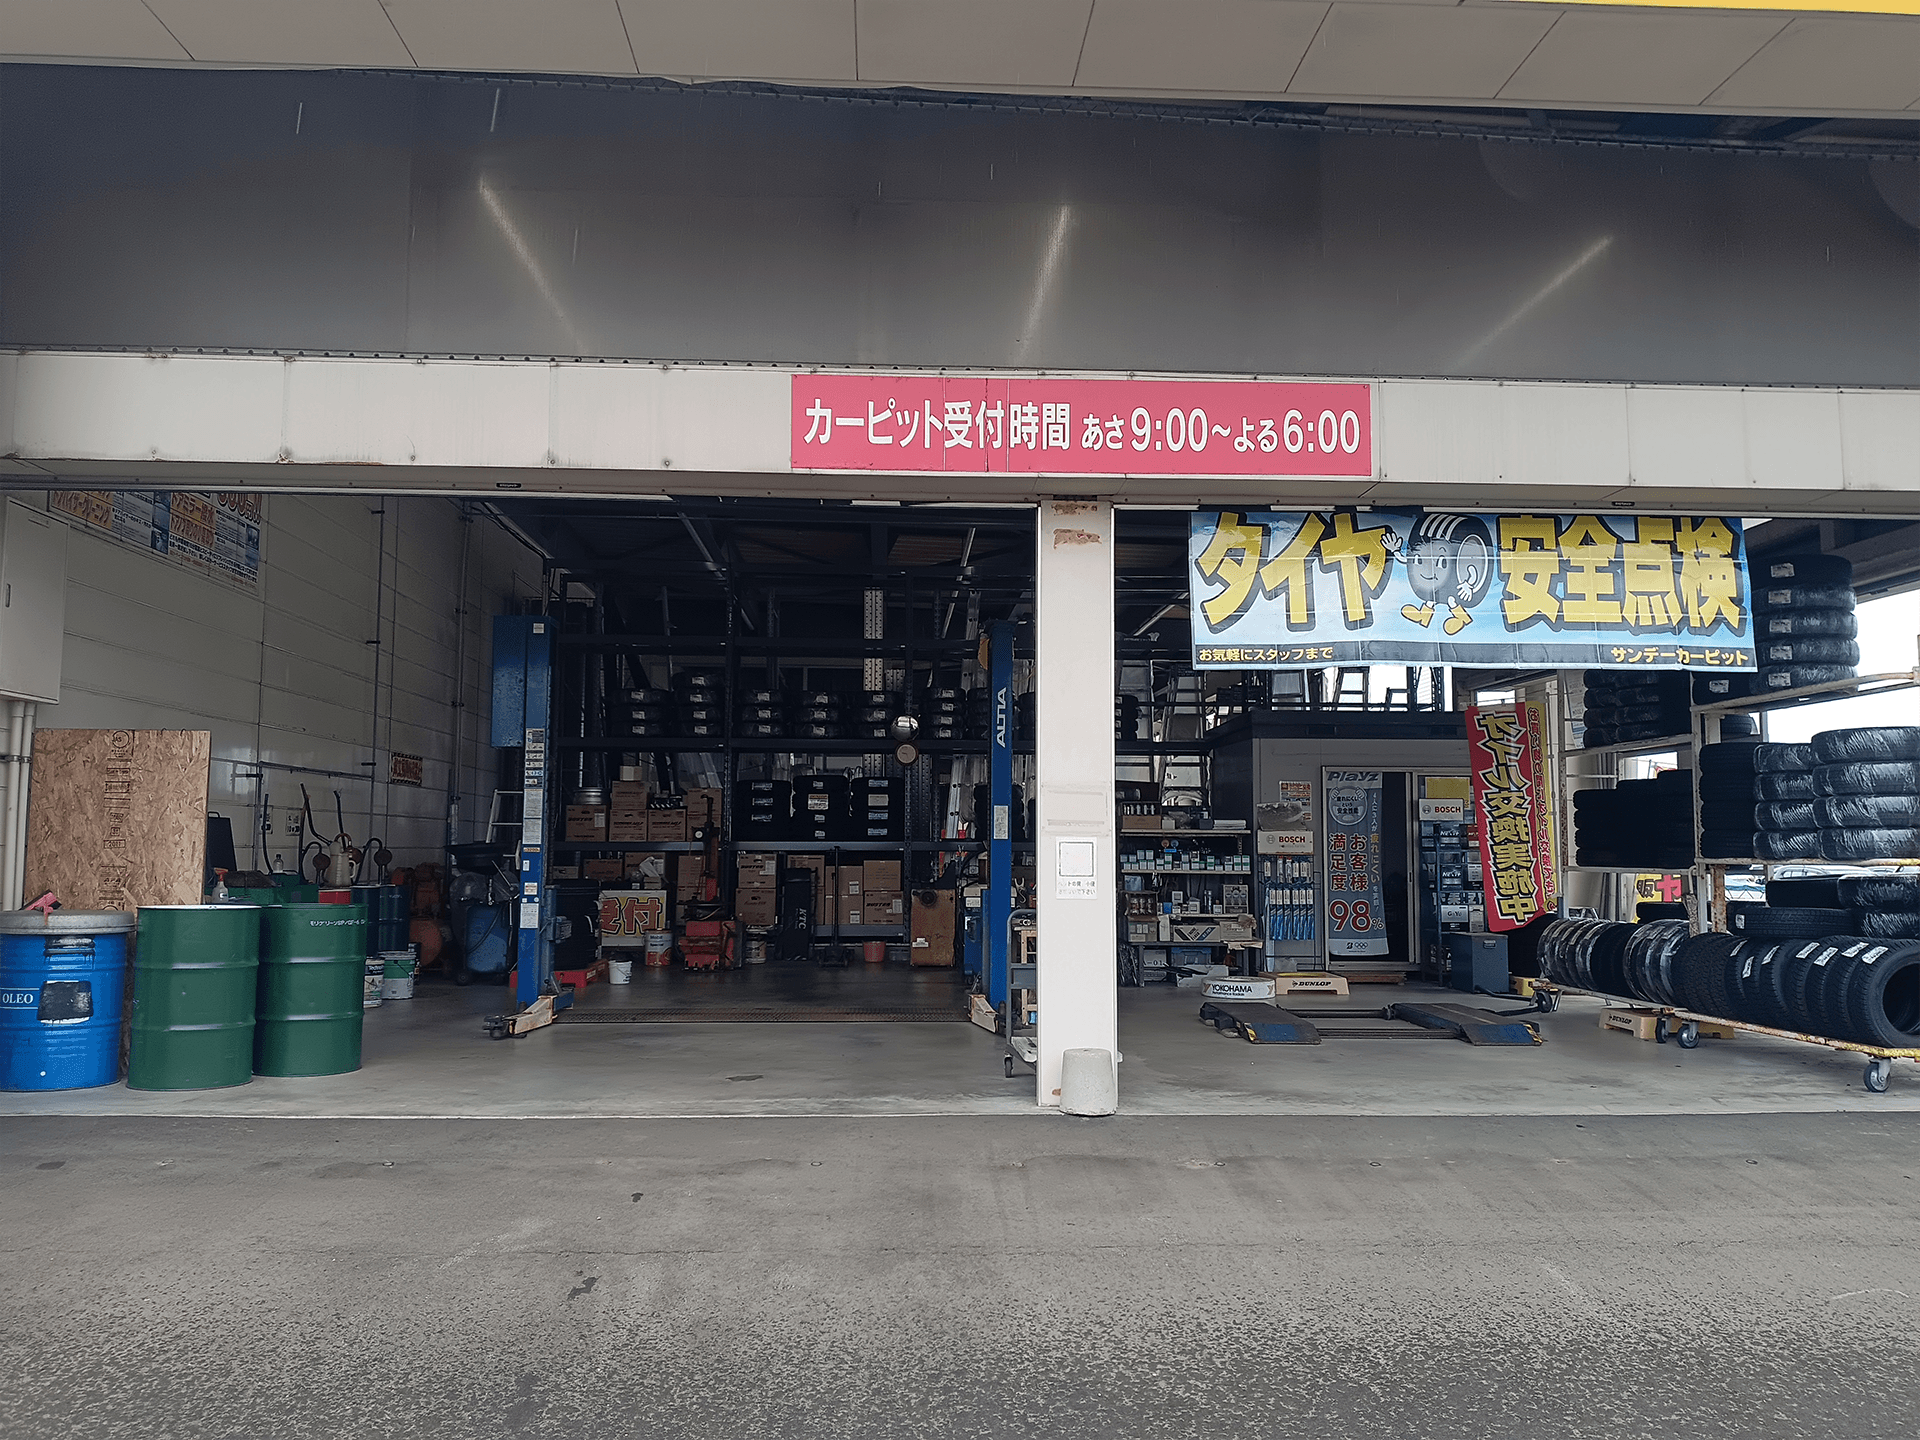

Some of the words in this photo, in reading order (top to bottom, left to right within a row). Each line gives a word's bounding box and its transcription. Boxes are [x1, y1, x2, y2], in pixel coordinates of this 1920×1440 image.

[804, 398, 1071, 450] カーピット受付時間
[1198, 511, 1391, 633] タイヤ
[1499, 513, 1745, 634] 安全点検
[1198, 647, 1334, 662] お気軽にスタッフまで
[1610, 646, 1750, 667] サンデーカーピット
[1327, 771, 1380, 782] Playz
[1328, 832, 1348, 892] 満足度
[1349, 832, 1369, 891] お客様
[799, 907, 808, 931] KTC
[1211, 983, 1253, 993] YOKOHAMA
[2, 993, 34, 1005] OLEO
[1611, 1015, 1633, 1025] DUNLOP
